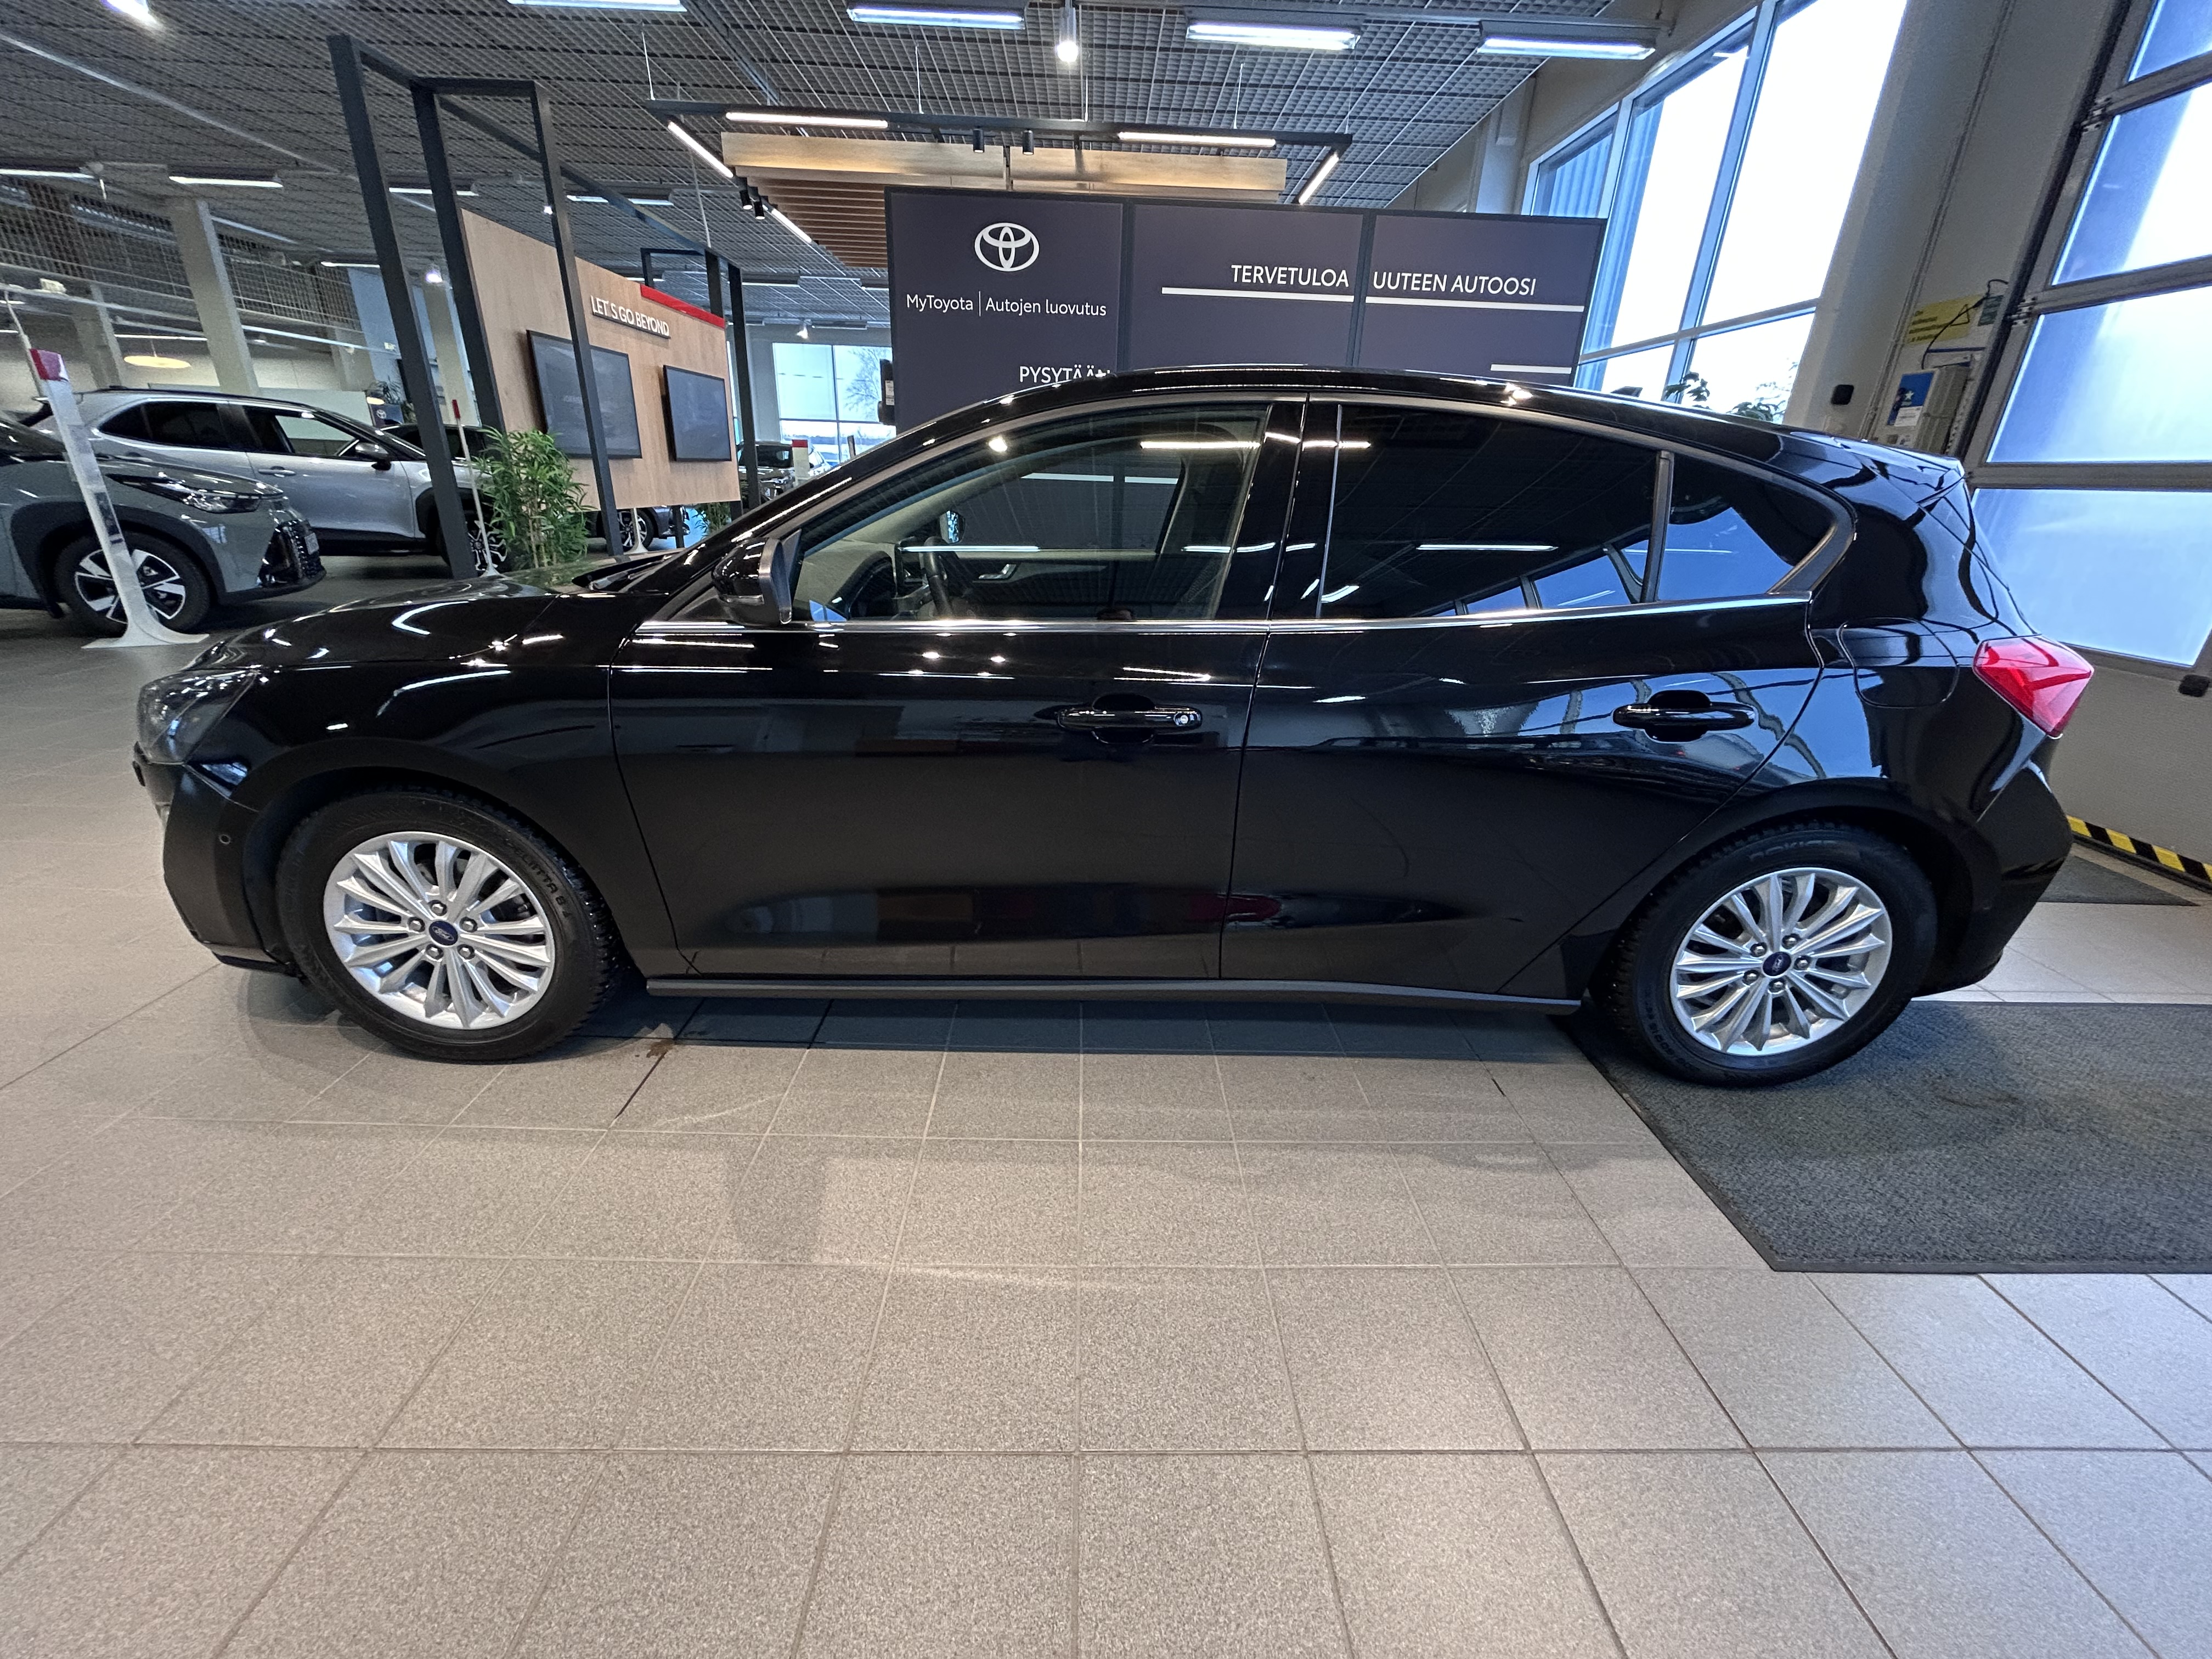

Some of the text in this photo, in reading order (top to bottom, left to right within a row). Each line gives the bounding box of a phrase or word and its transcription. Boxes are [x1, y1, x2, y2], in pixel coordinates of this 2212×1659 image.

[1231, 264, 1536, 295] TERVETULOA UUTEEN AUTOOSI
[906, 294, 1107, 317] MyToyota Autojen luovutus
[618, 306, 635, 325] GO
[635, 311, 670, 337] BEYOND
